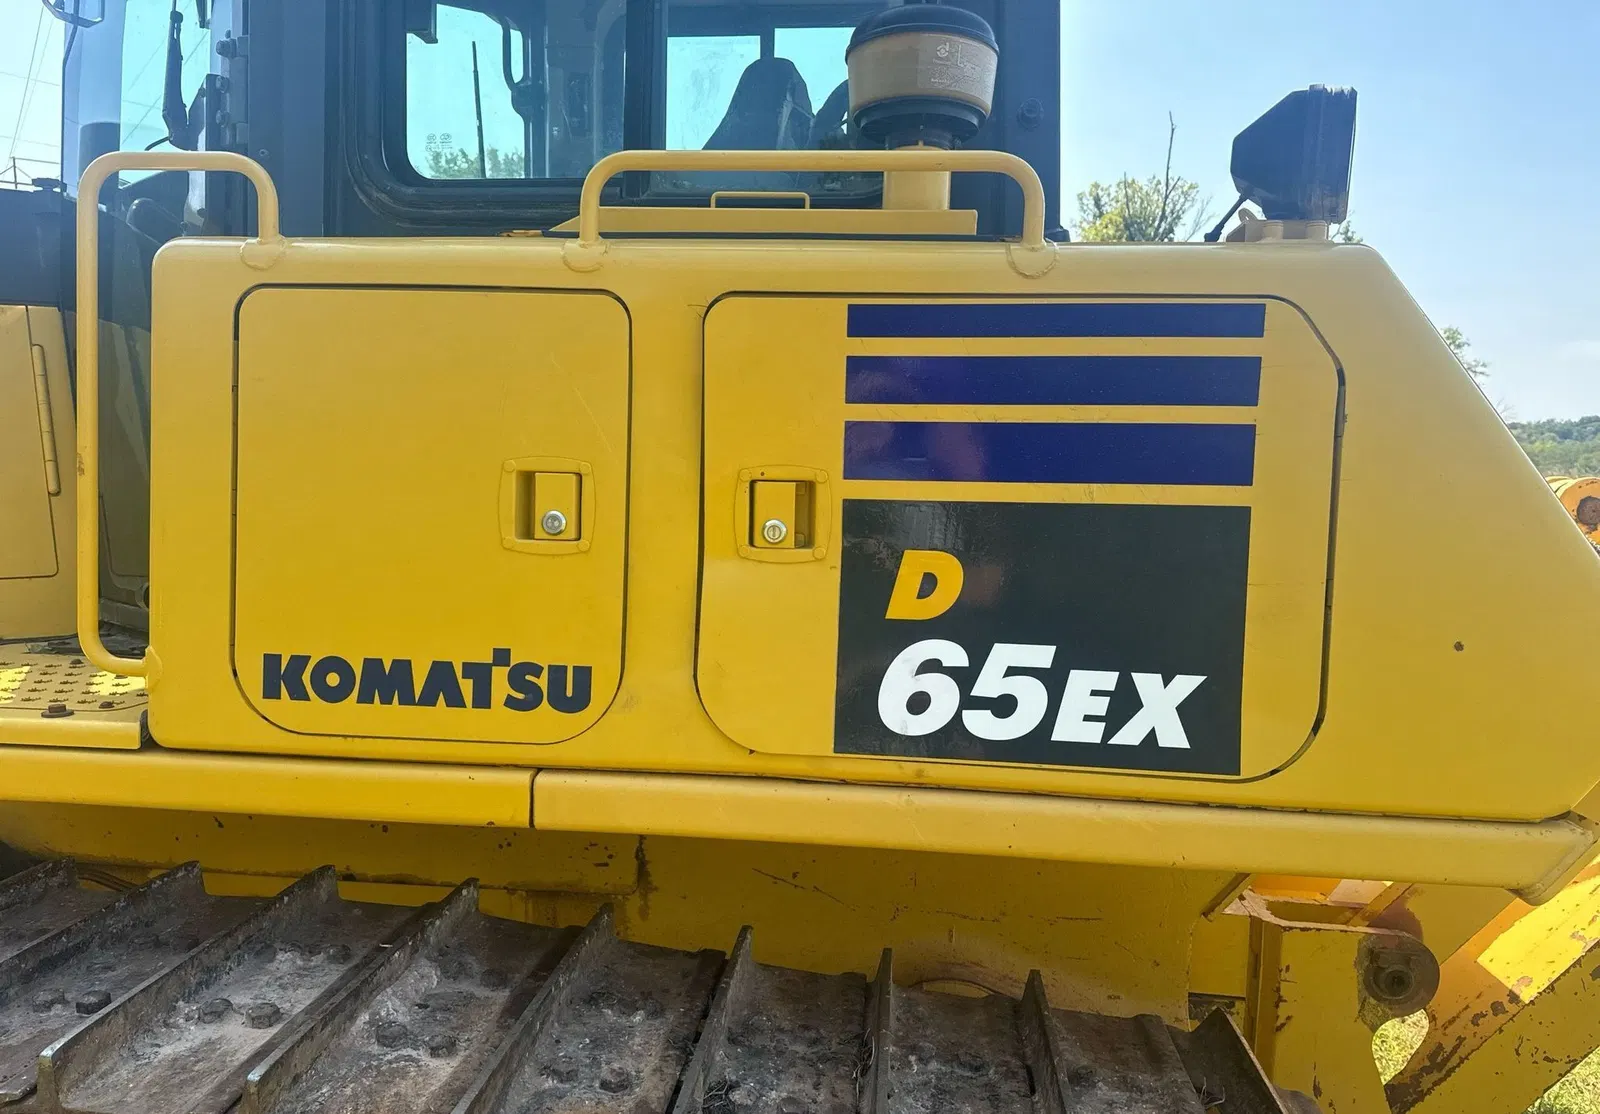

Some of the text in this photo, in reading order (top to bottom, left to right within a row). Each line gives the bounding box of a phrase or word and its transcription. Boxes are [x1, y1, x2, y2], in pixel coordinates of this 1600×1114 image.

[885, 550, 964, 621] D
[262, 648, 593, 714] KOMATSU
[877, 639, 1207, 750] 65EX
